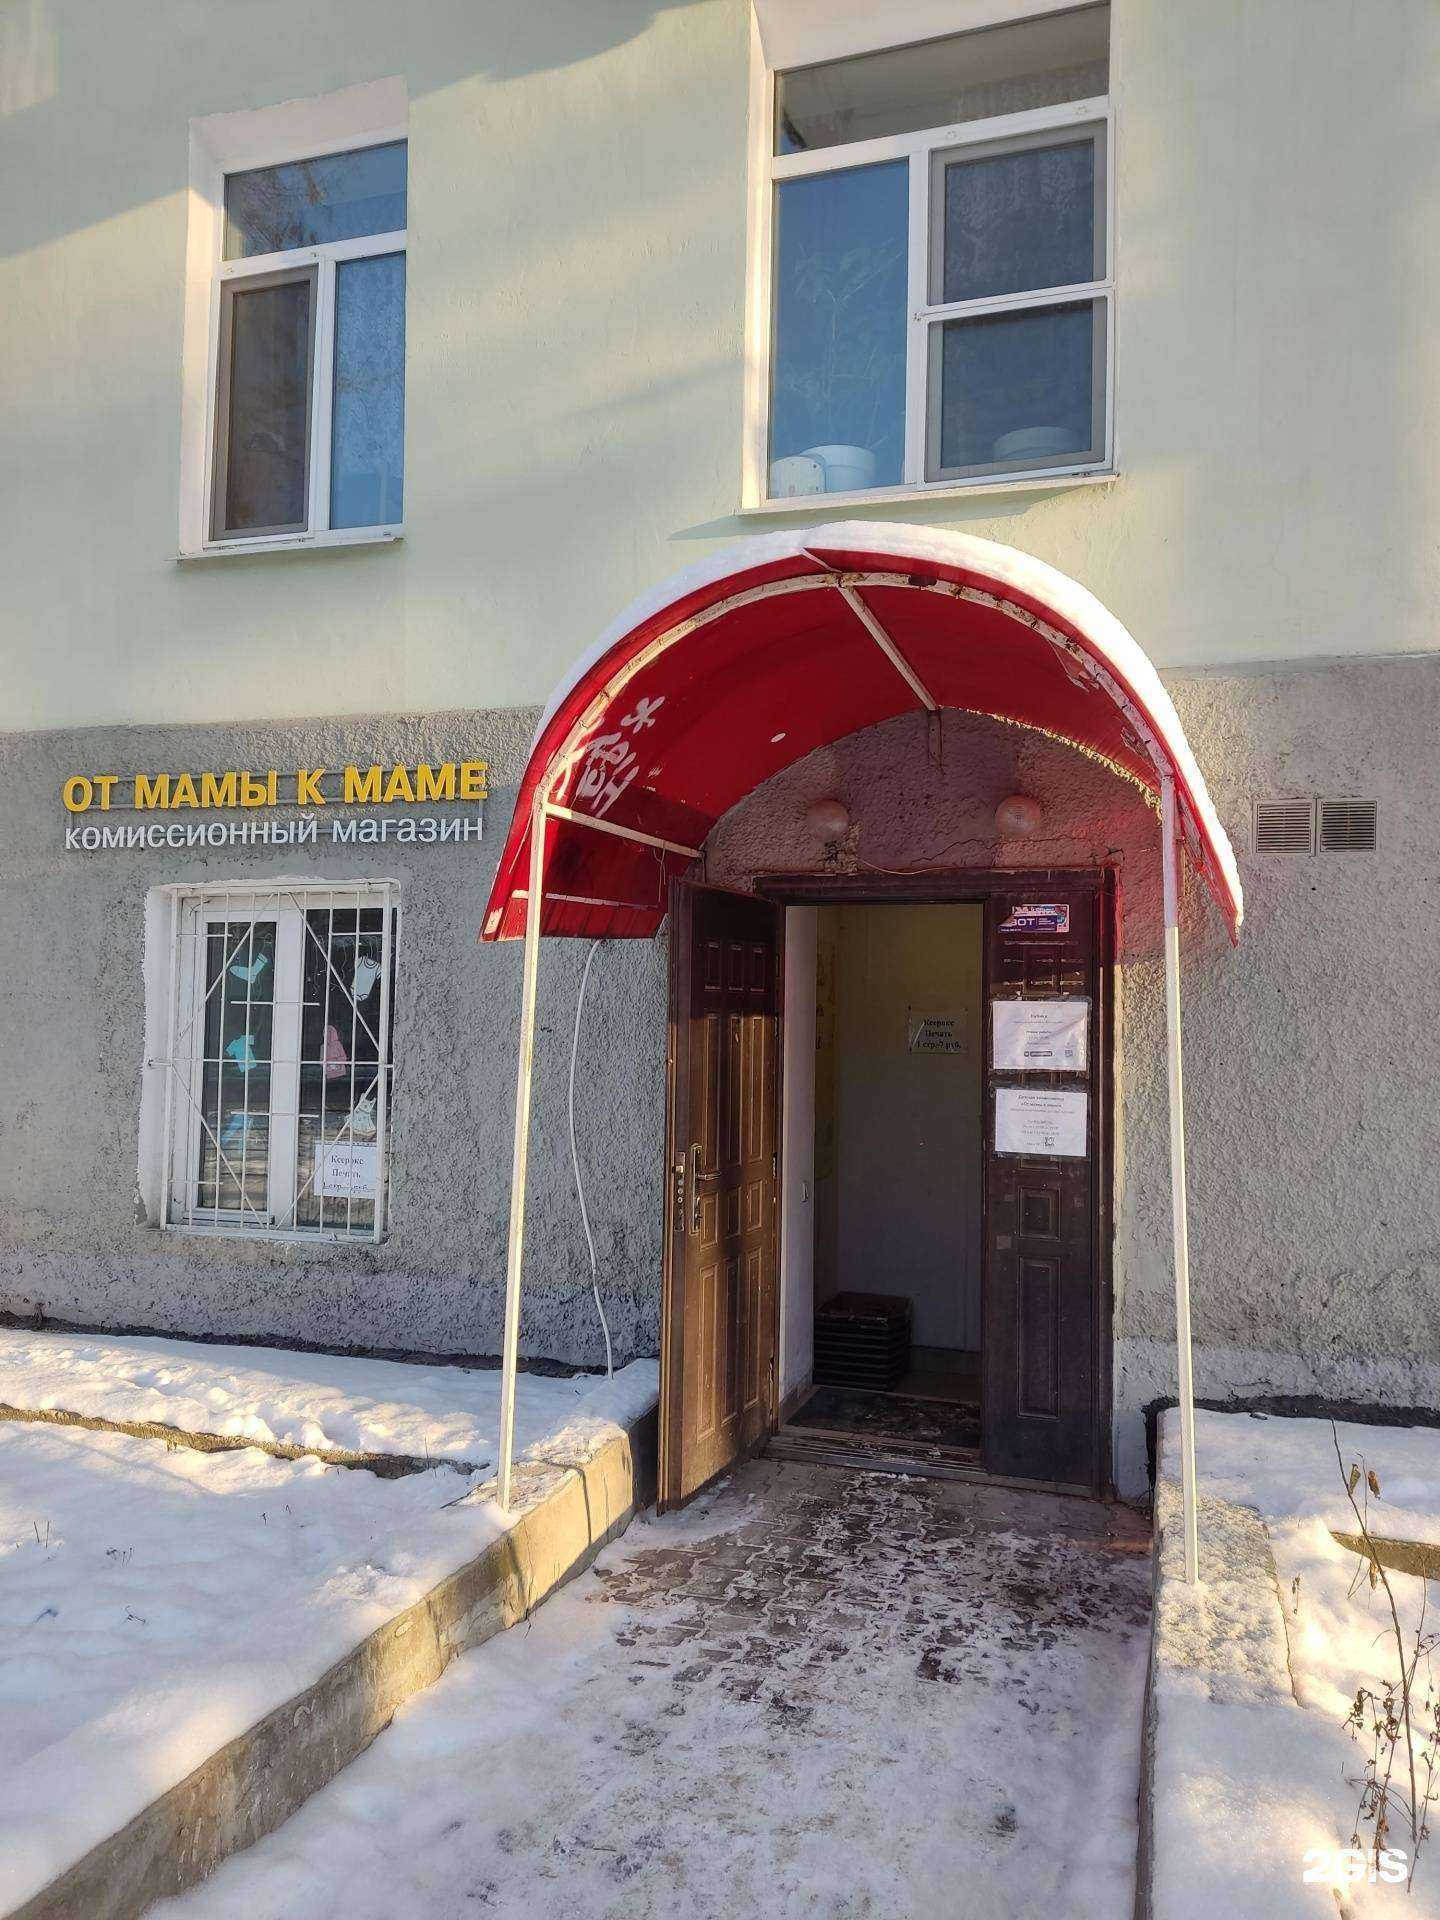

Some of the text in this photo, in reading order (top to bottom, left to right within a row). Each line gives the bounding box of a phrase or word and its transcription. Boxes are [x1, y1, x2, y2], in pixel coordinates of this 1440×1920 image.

[62, 762, 489, 812] ОТ МАМЫ К МАМЕ
[65, 813, 484, 850] комиссионный магазин
